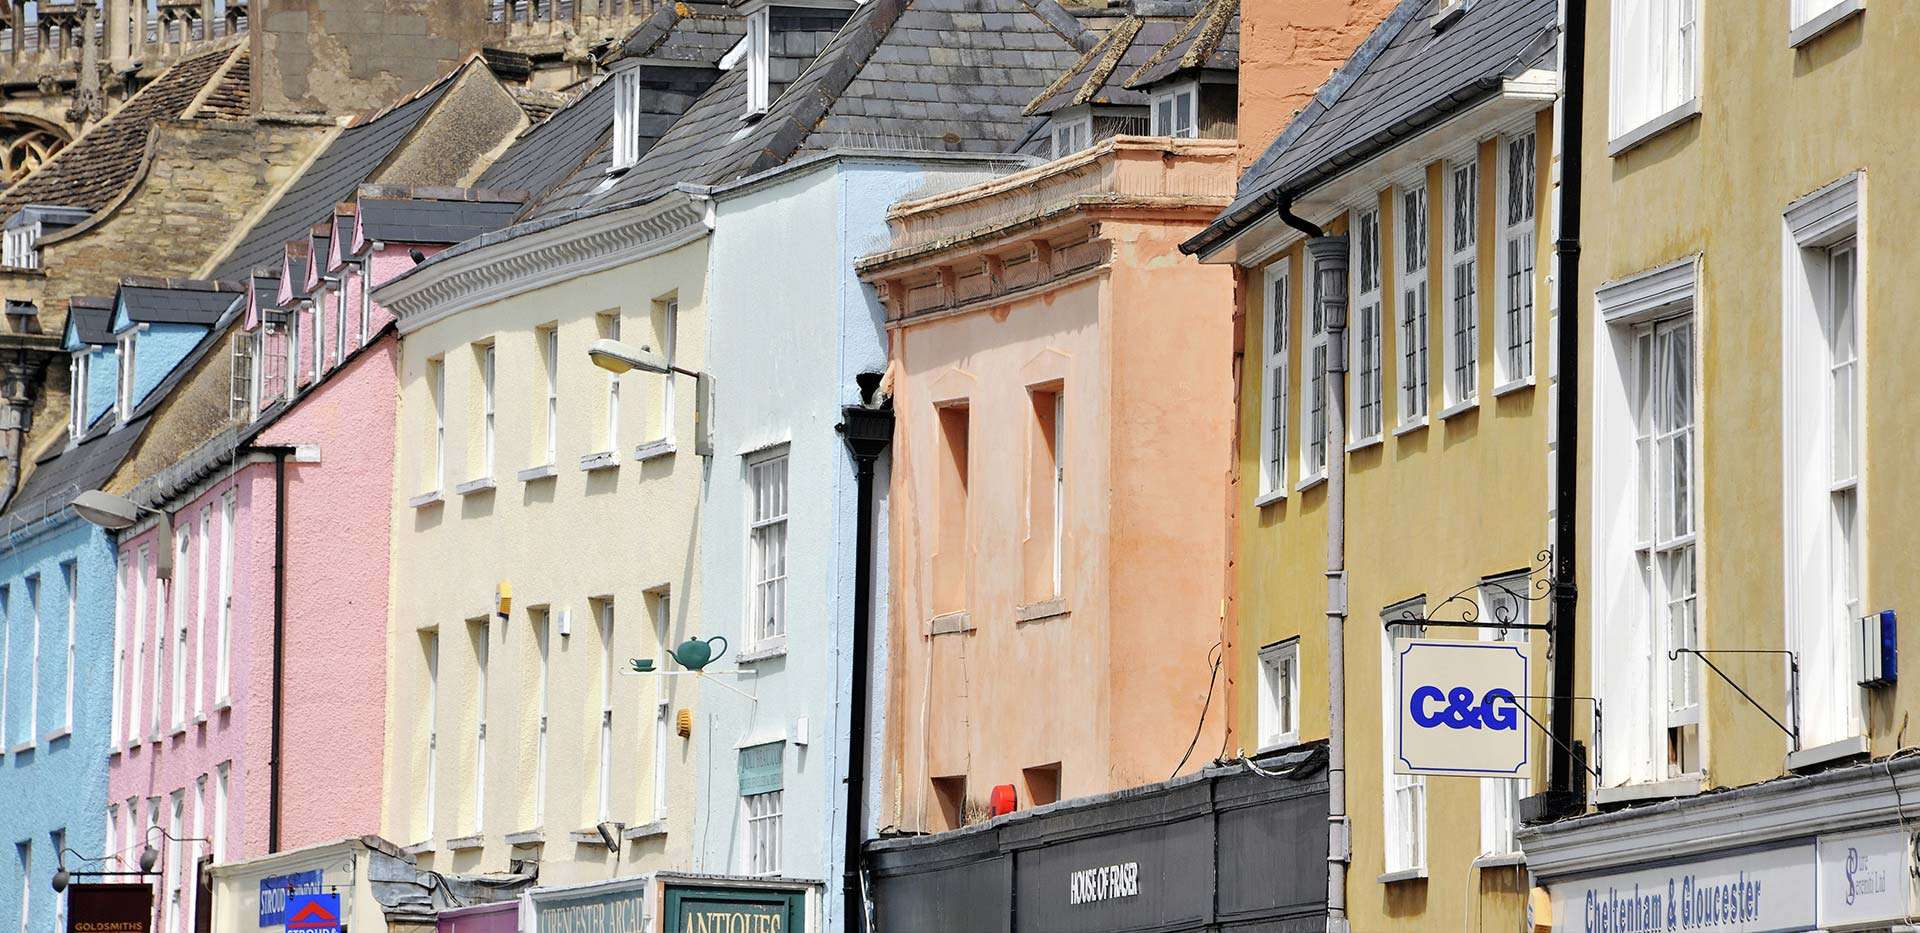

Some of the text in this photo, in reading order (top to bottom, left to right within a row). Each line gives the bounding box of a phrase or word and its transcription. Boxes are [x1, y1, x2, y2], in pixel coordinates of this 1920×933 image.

[1410, 685, 1517, 731] C&G
[261, 888, 286, 915] STROUD
[1071, 862, 1138, 905] HOUSE OF FRASER
[1585, 883, 1662, 933] Cheltenham
[1667, 877, 1677, 929] &
[1682, 870, 1762, 928] Gloucester
[75, 922, 143, 931] GOLDSMITHS
